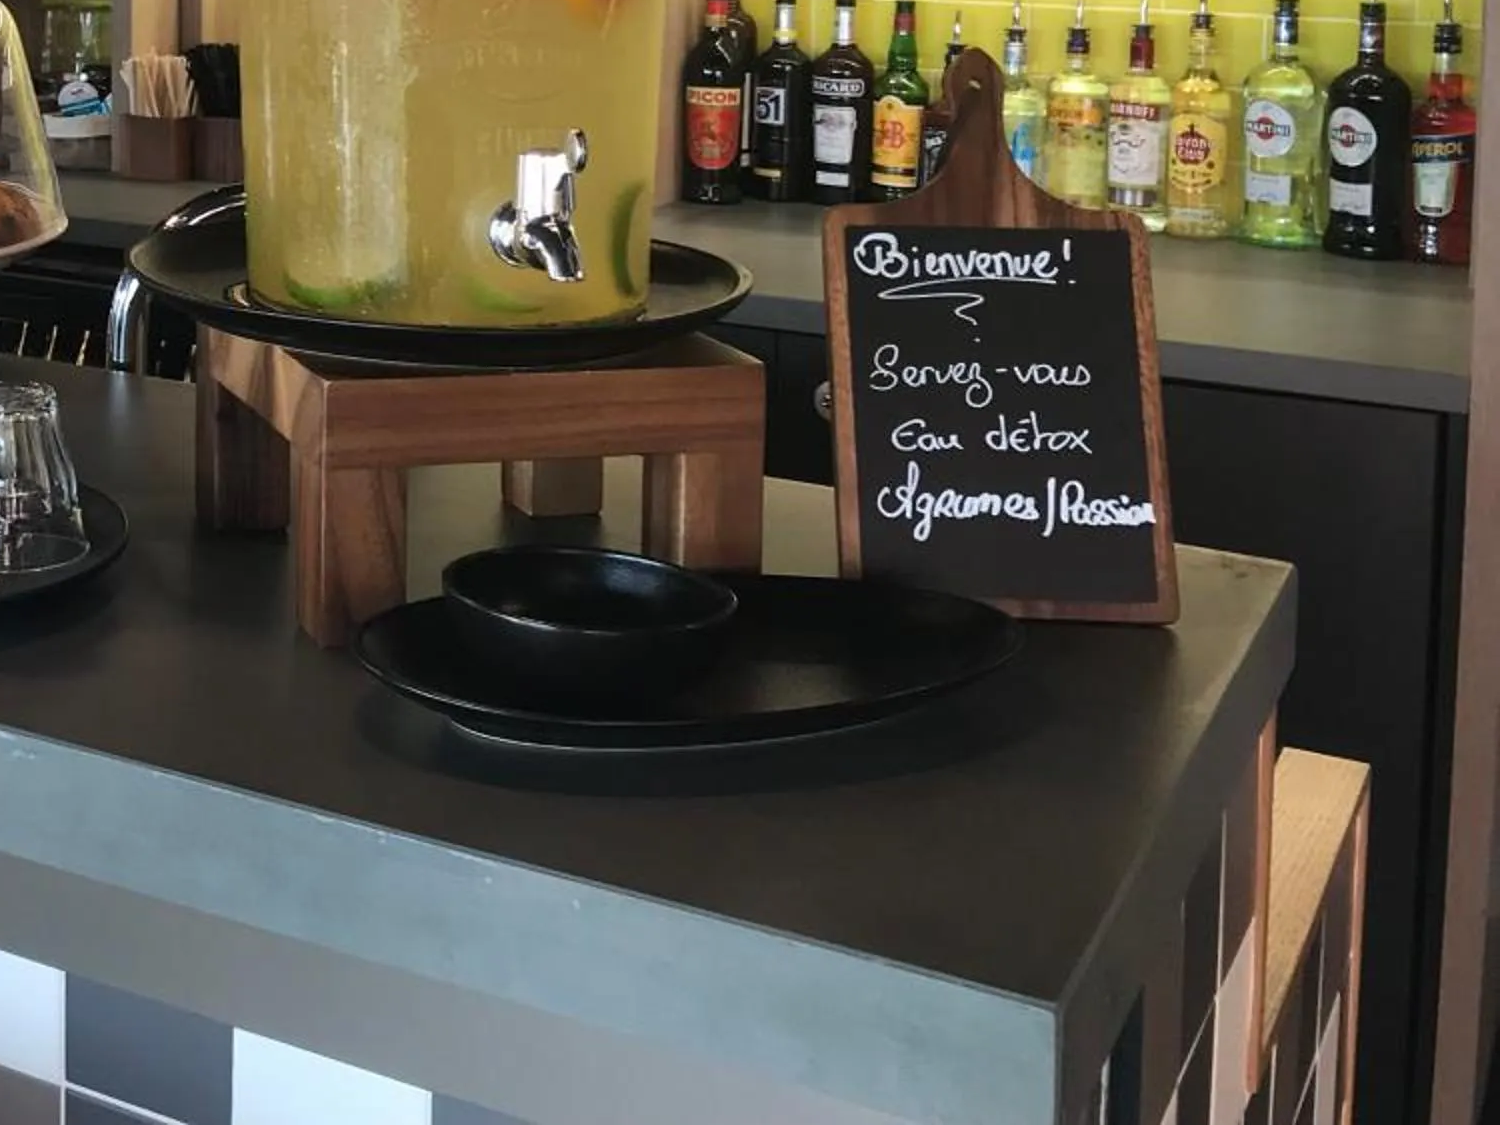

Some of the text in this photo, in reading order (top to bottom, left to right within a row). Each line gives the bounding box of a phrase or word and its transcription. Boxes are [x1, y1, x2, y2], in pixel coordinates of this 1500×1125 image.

[757, 94, 781, 122] 51
[869, 344, 1092, 408] Servez-vous
[891, 418, 964, 452] Eau
